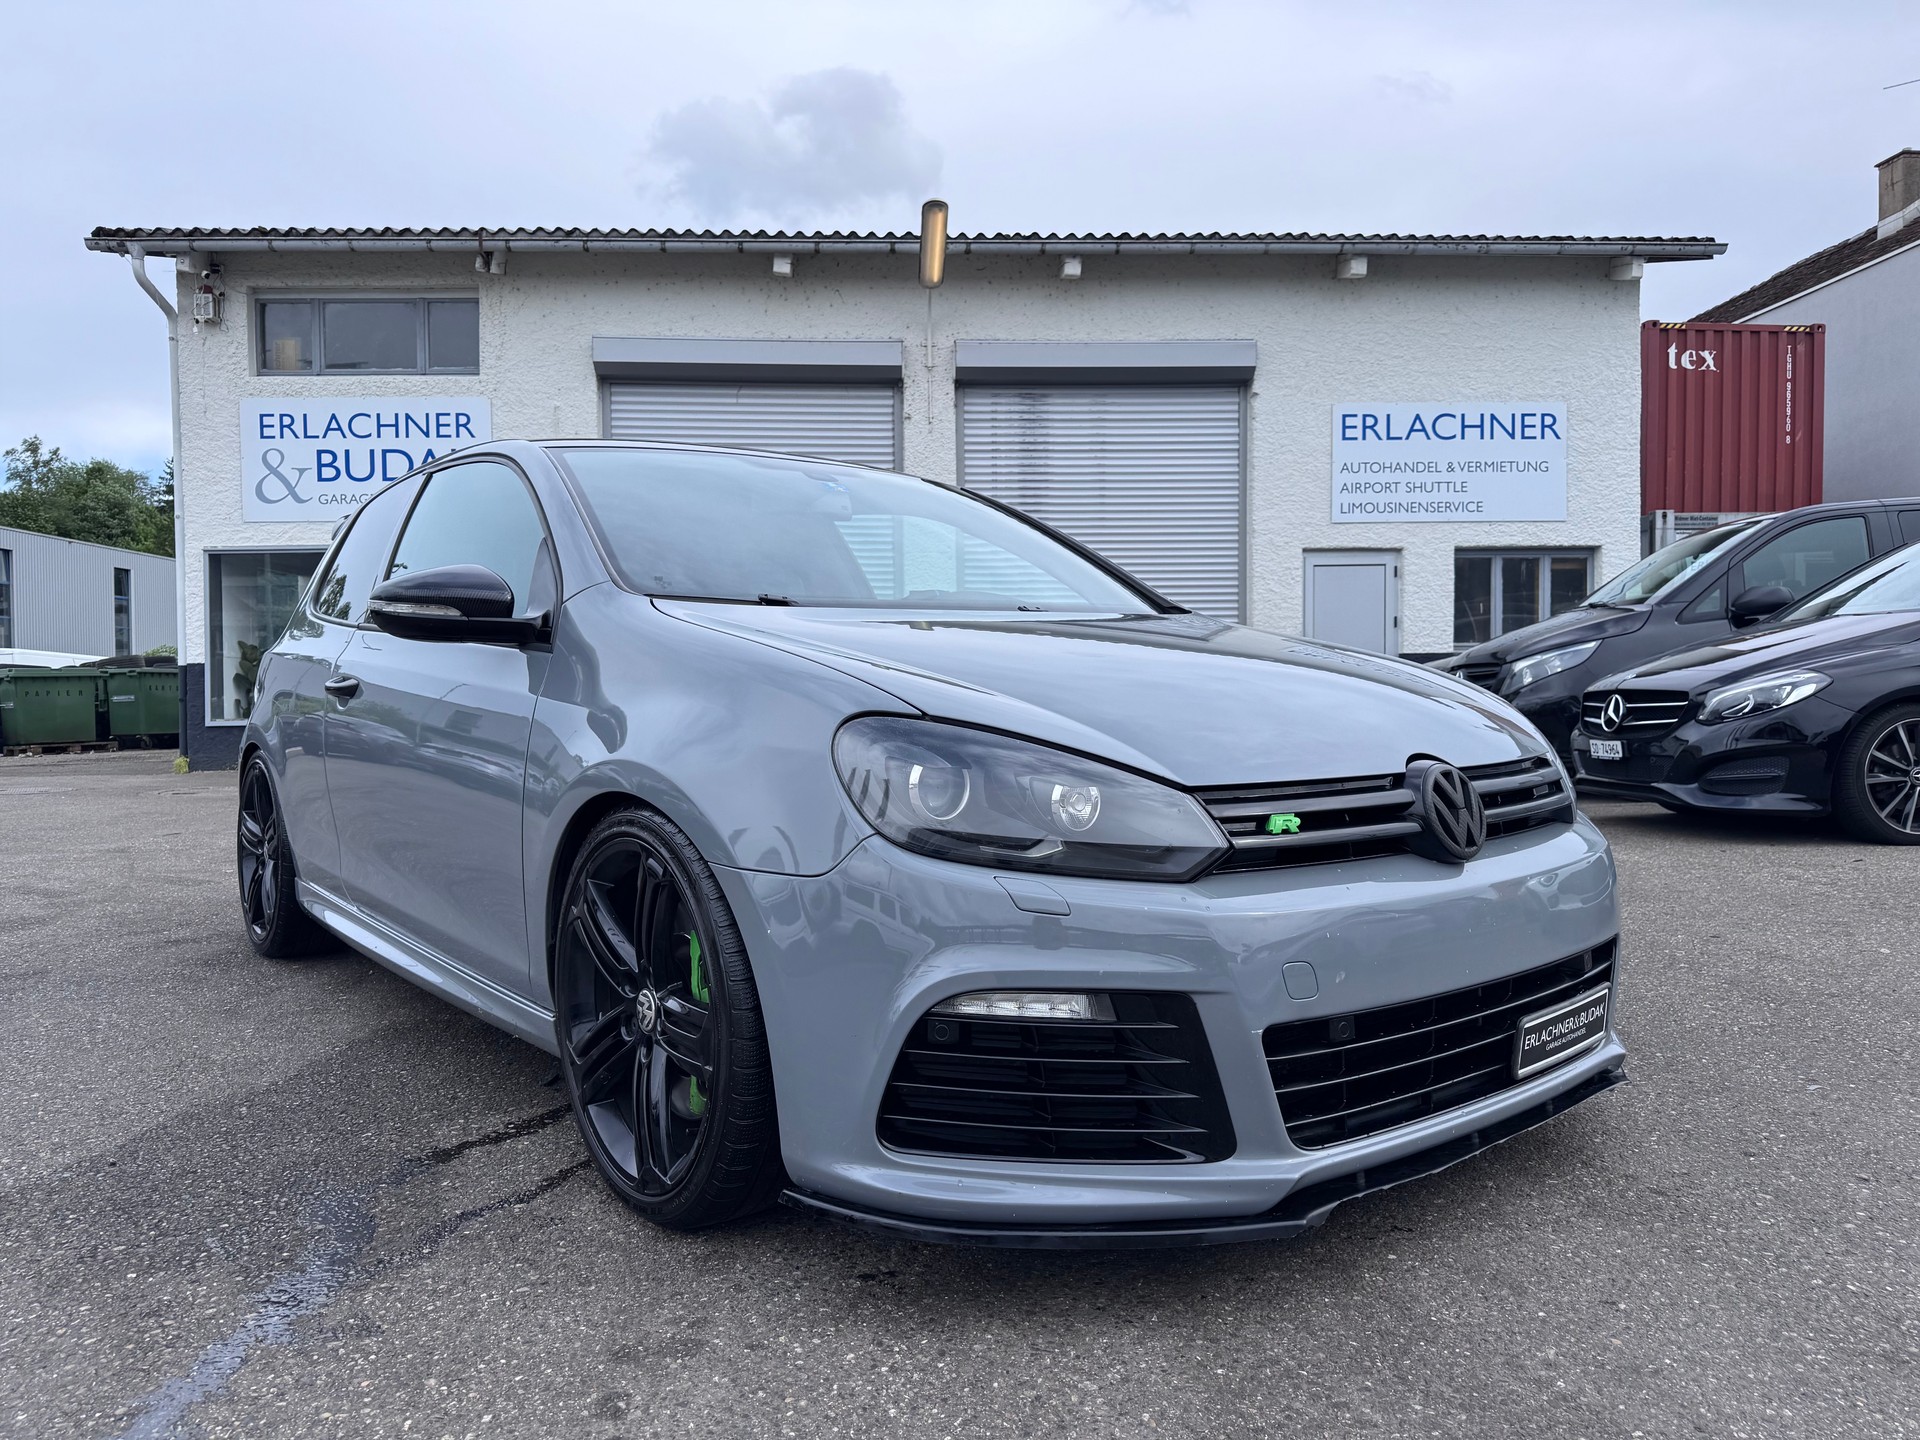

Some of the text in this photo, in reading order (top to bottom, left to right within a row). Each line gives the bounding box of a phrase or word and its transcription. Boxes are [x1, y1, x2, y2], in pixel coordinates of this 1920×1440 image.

[1667, 342, 1717, 371] tex
[258, 412, 476, 440] ERLACHNER
[1341, 412, 1562, 441] ERLACHNER
[1785, 435, 1791, 444] 8
[1340, 460, 1550, 474] AUTOHANDEL & VERMIETUNG
[254, 448, 313, 505] &
[1340, 481, 1468, 494] AIRPORT SHUTTLE
[318, 493, 373, 505] GARAG
[1340, 501, 1484, 514] LIMOUSINENSERVICE
